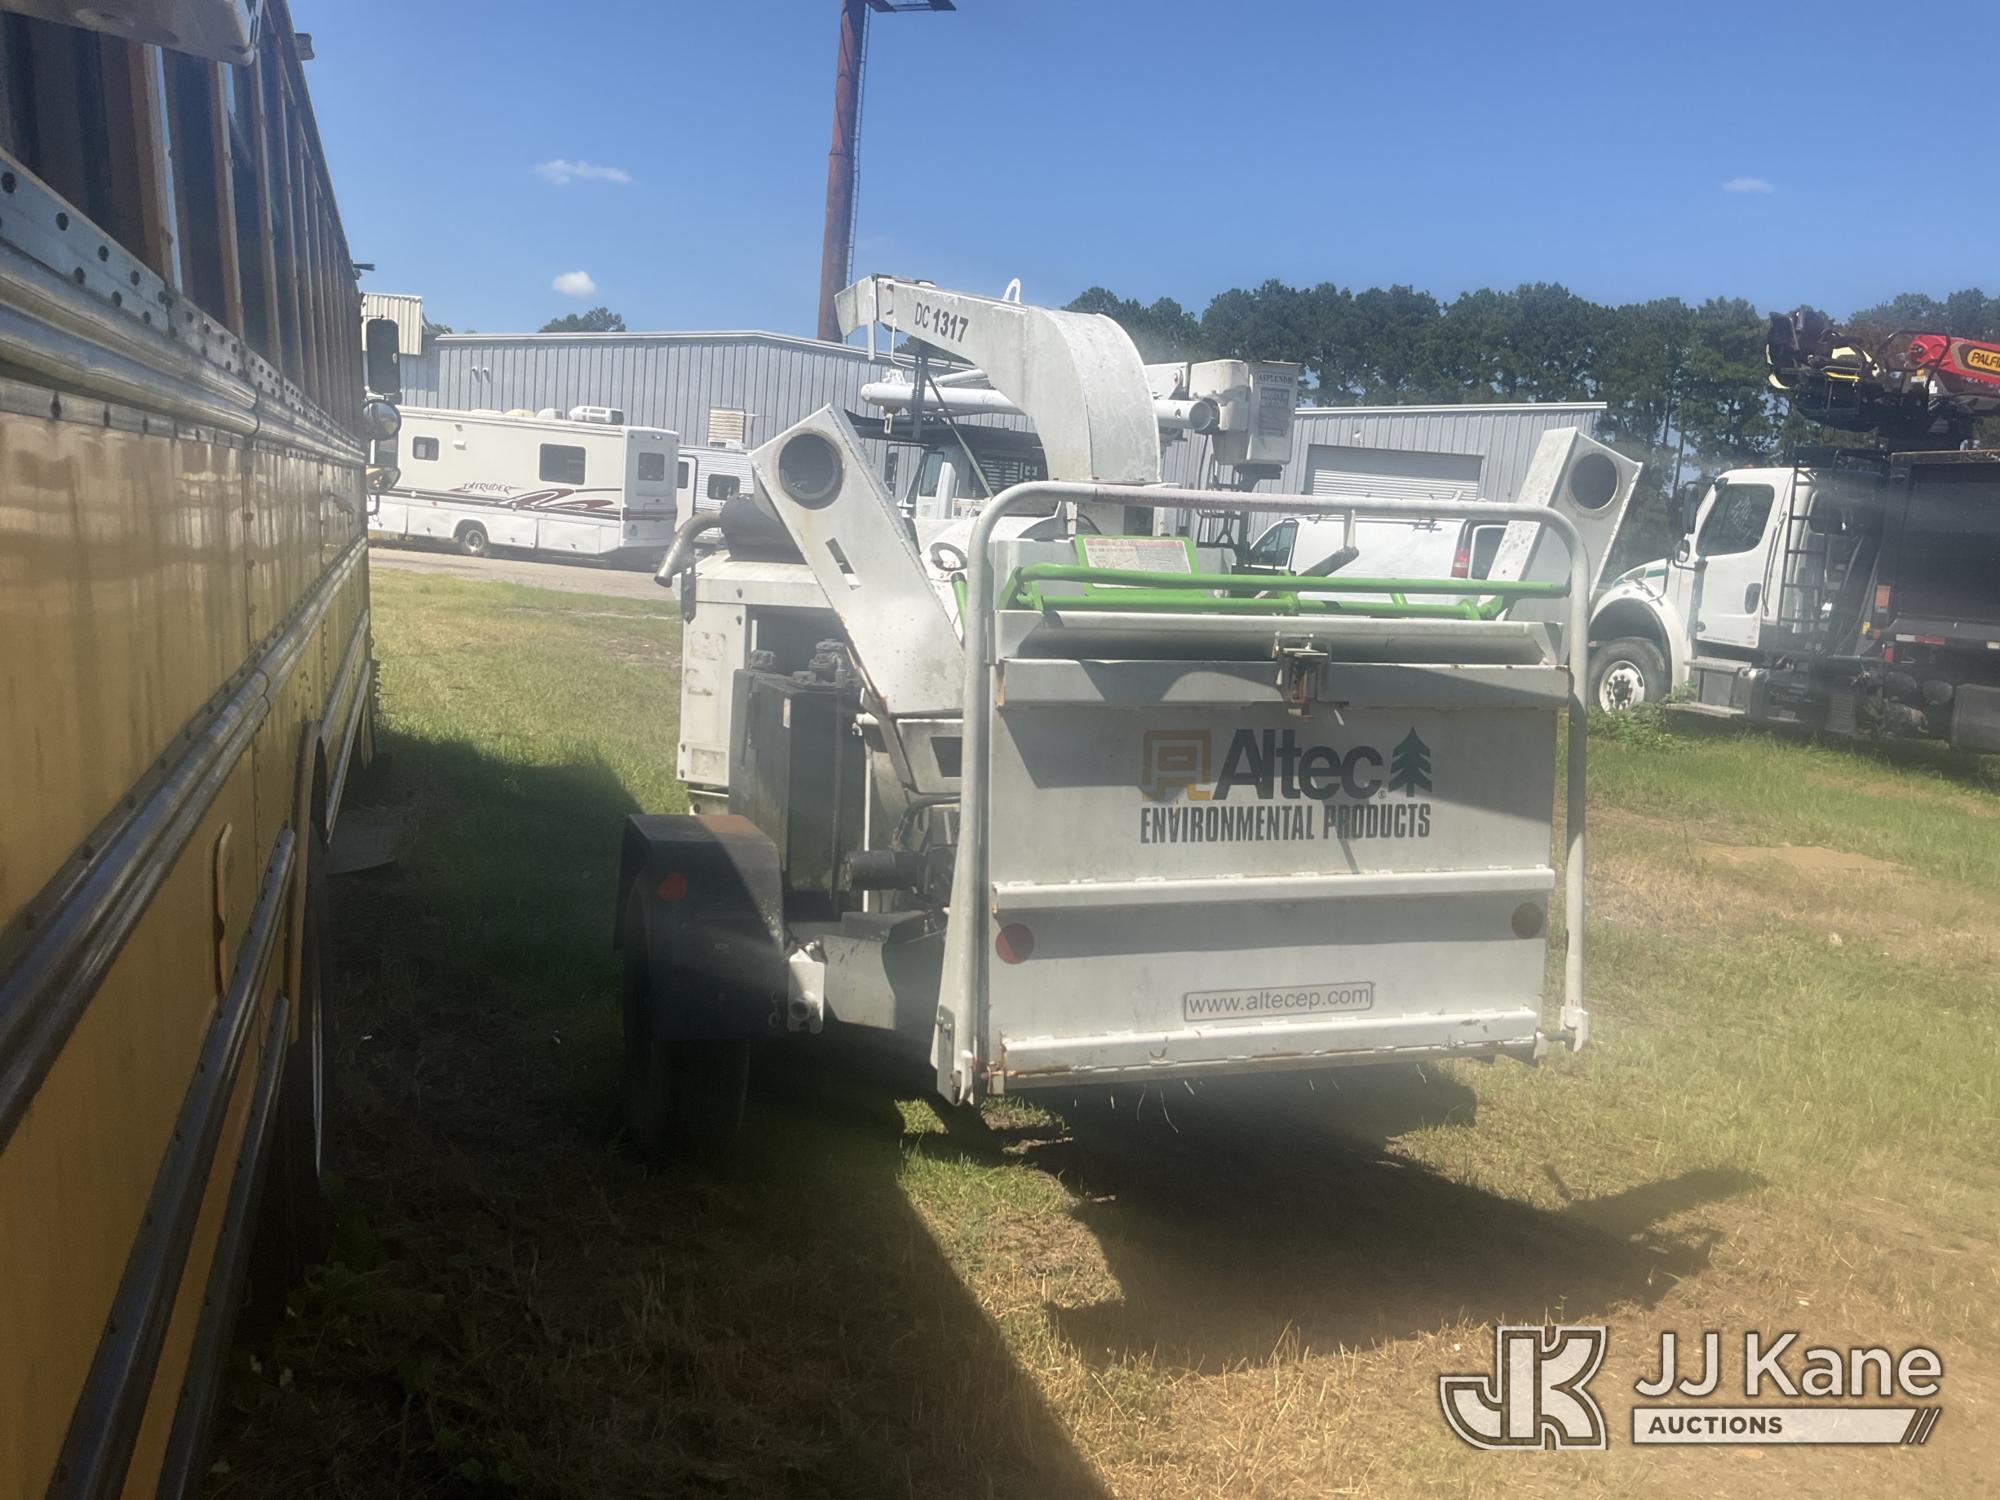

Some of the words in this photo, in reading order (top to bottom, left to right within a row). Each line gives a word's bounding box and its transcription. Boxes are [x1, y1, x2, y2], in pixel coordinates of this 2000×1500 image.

[914, 302, 930, 328] DC
[933, 308, 969, 343] 1317
[1971, 351, 2000, 369] PALFI
[1212, 728, 1384, 800] Altec
[1140, 804, 1315, 844] ENVIRONMENTAL
[1323, 803, 1431, 840] PRODUCTS
[1189, 988, 1369, 1014] www.altecep.com
